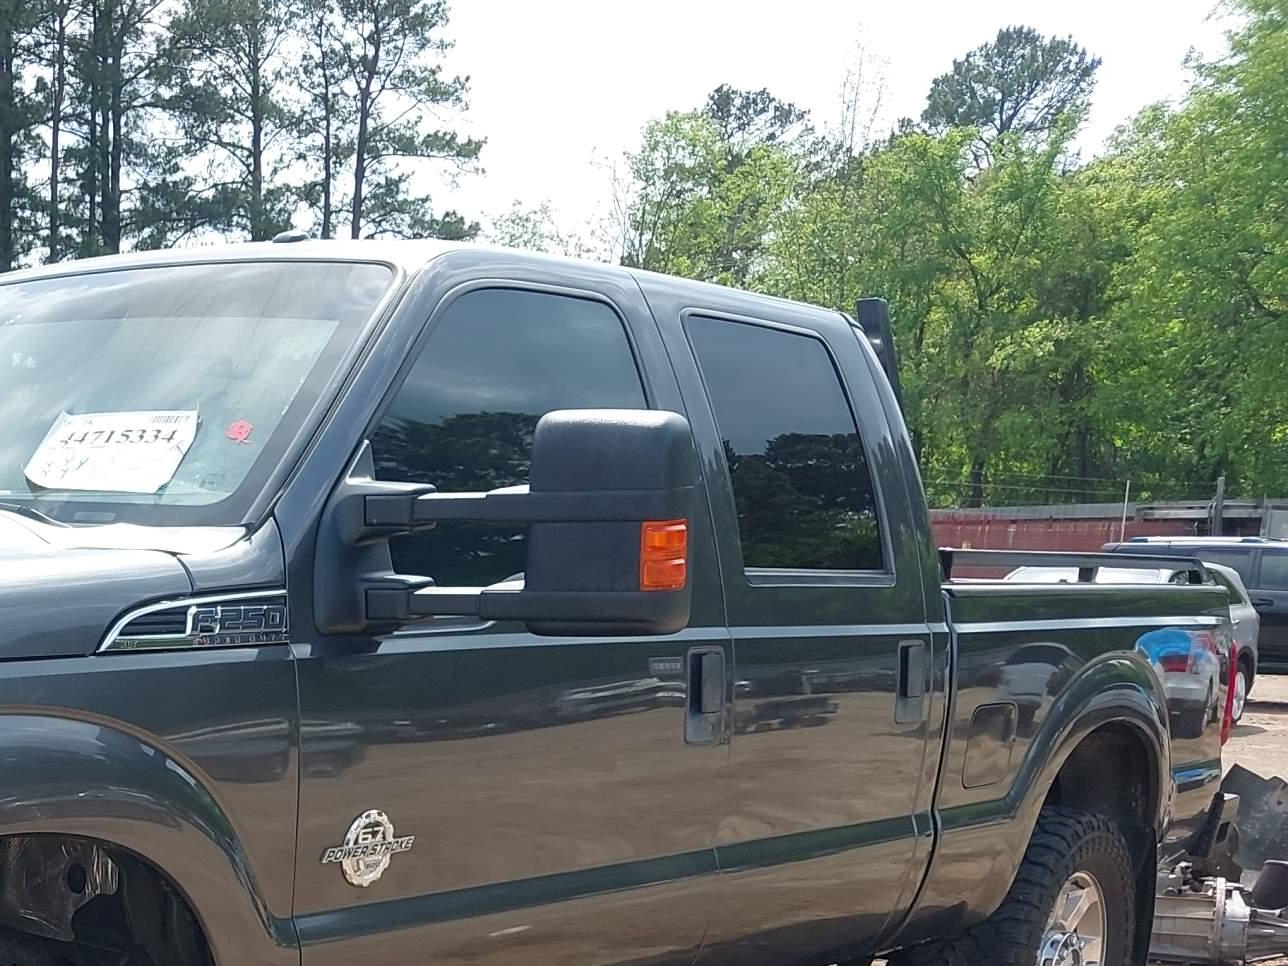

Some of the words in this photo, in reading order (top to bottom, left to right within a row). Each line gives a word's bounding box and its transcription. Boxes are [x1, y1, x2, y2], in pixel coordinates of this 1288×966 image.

[59, 428, 179, 445] 44715334
[357, 826, 386, 844] 6.7
[324, 846, 369, 863] POWER
[369, 836, 414, 857] STROKE
